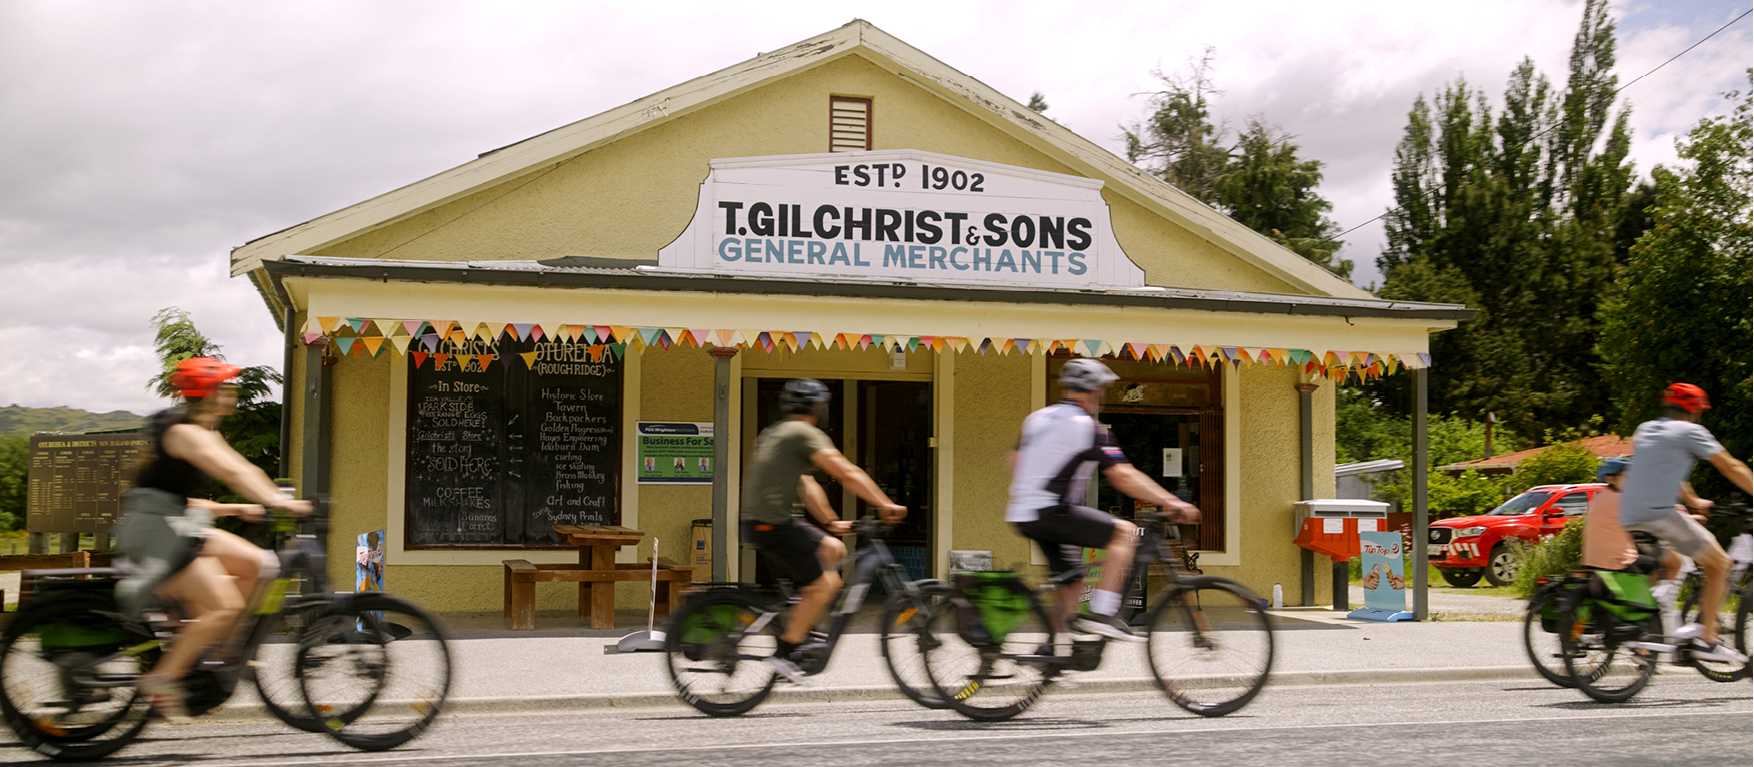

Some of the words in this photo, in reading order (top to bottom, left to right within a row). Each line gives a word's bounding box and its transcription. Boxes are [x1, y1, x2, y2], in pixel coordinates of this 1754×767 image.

[922, 164, 985, 193] 1902
[982, 212, 1093, 252] SONS
[719, 239, 872, 268] GENERAL
[882, 244, 1088, 274] MERCHANTS
[535, 343, 614, 364] OTUREHA
[438, 380, 450, 392] In
[453, 381, 480, 393] Store
[579, 387, 604, 402] Store
[553, 400, 588, 413] Tavern
[545, 412, 607, 424] Backpackers
[540, 422, 570, 433] Golden
[642, 436, 686, 446] Business
[686, 437, 702, 446] For
[436, 487, 484, 499] COFFEE
[566, 496, 582, 506] and
[583, 495, 606, 507] Craft
[547, 510, 577, 525] Sydney
[579, 510, 604, 522] Prints
